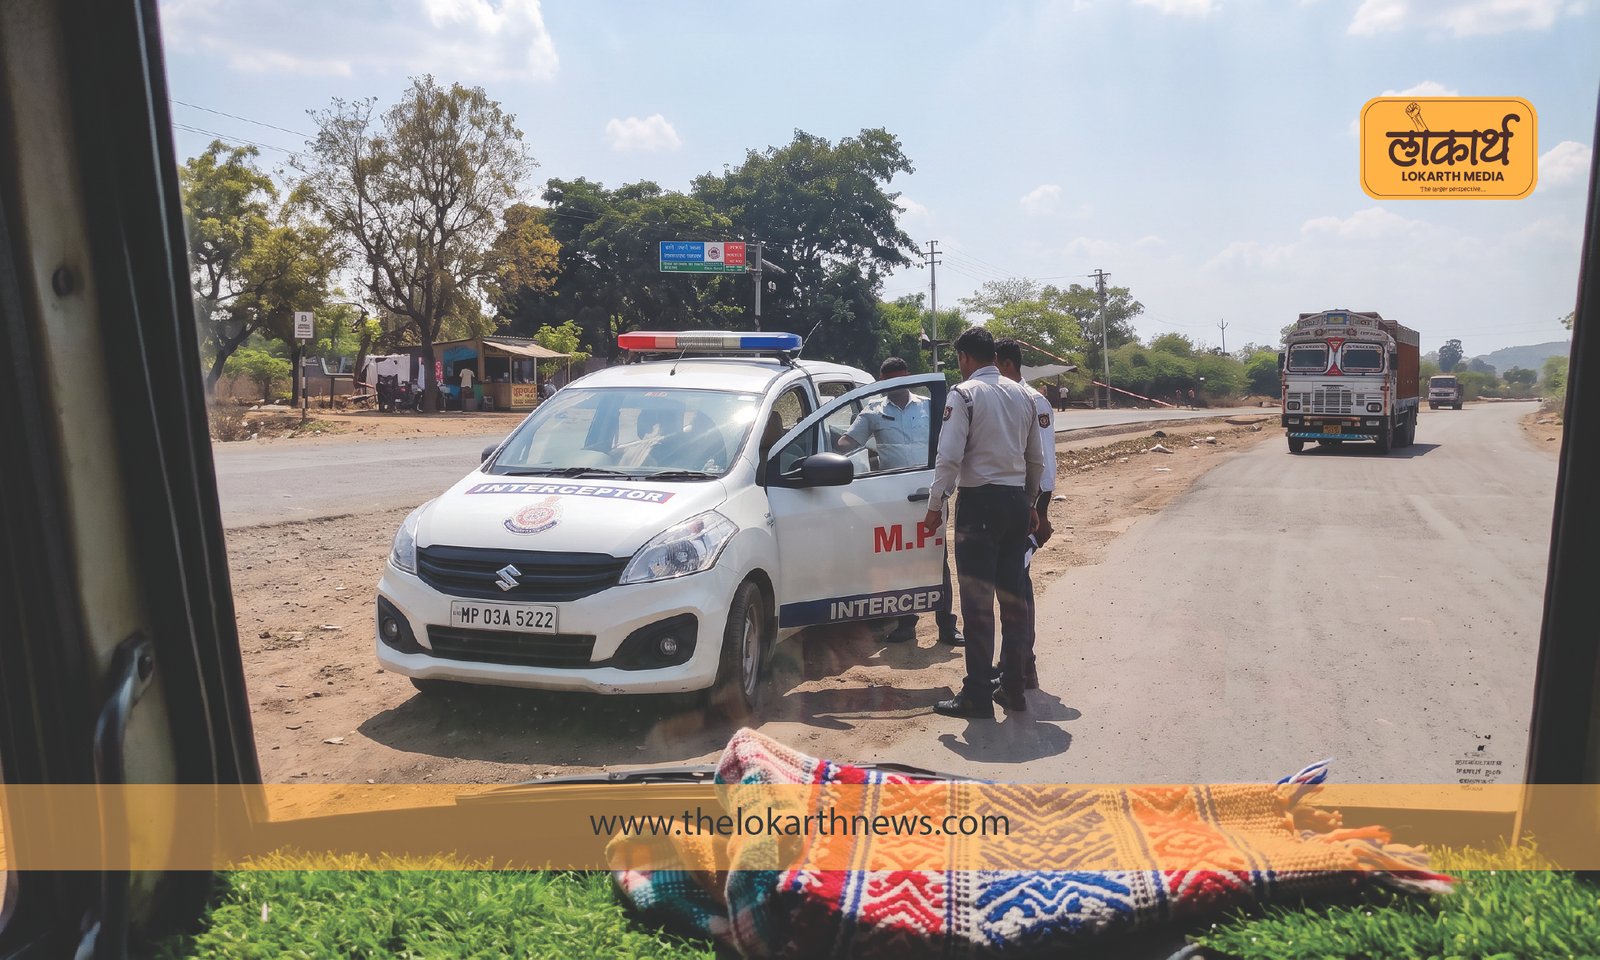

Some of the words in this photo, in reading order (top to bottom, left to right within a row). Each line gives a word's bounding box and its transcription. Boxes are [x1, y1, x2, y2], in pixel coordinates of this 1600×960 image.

[474, 483, 660, 502] INTERCEPTOR
[874, 521, 943, 553] M.P.
[461, 607, 479, 624] MP
[484, 609, 511, 626] 03A
[516, 610, 554, 629] 5222
